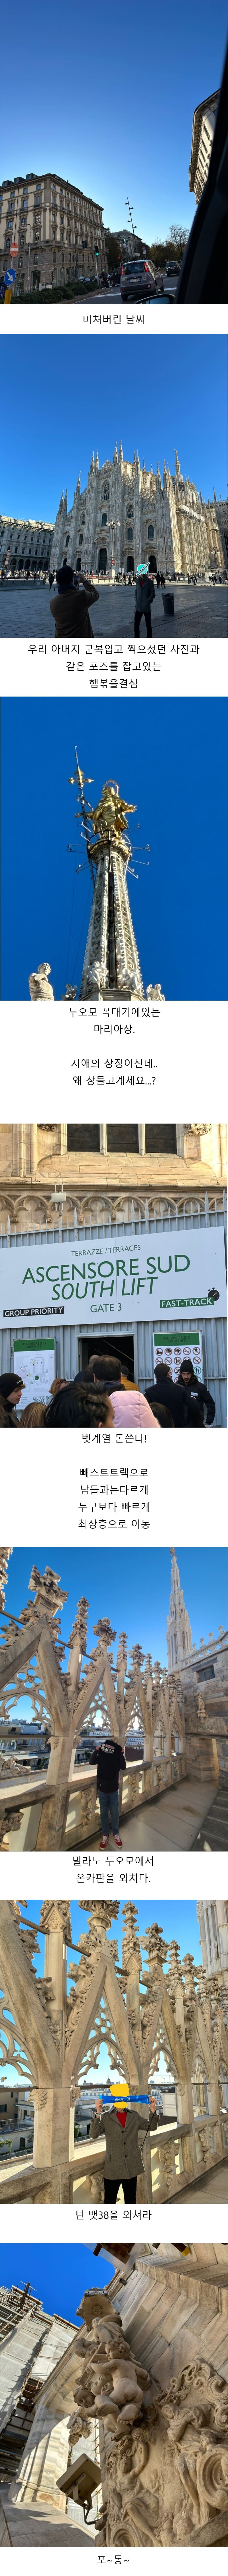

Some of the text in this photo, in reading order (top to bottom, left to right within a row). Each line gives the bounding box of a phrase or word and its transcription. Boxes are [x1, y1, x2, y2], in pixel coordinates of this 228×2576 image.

[108, 1245, 141, 1253] TERRACES
[22, 1254, 190, 1284] ASCENSORE SUD
[52, 1276, 158, 1300] SOUTH LIFT
[161, 1298, 212, 1307] FAST-TRACK
[90, 1304, 114, 1312] GATE
